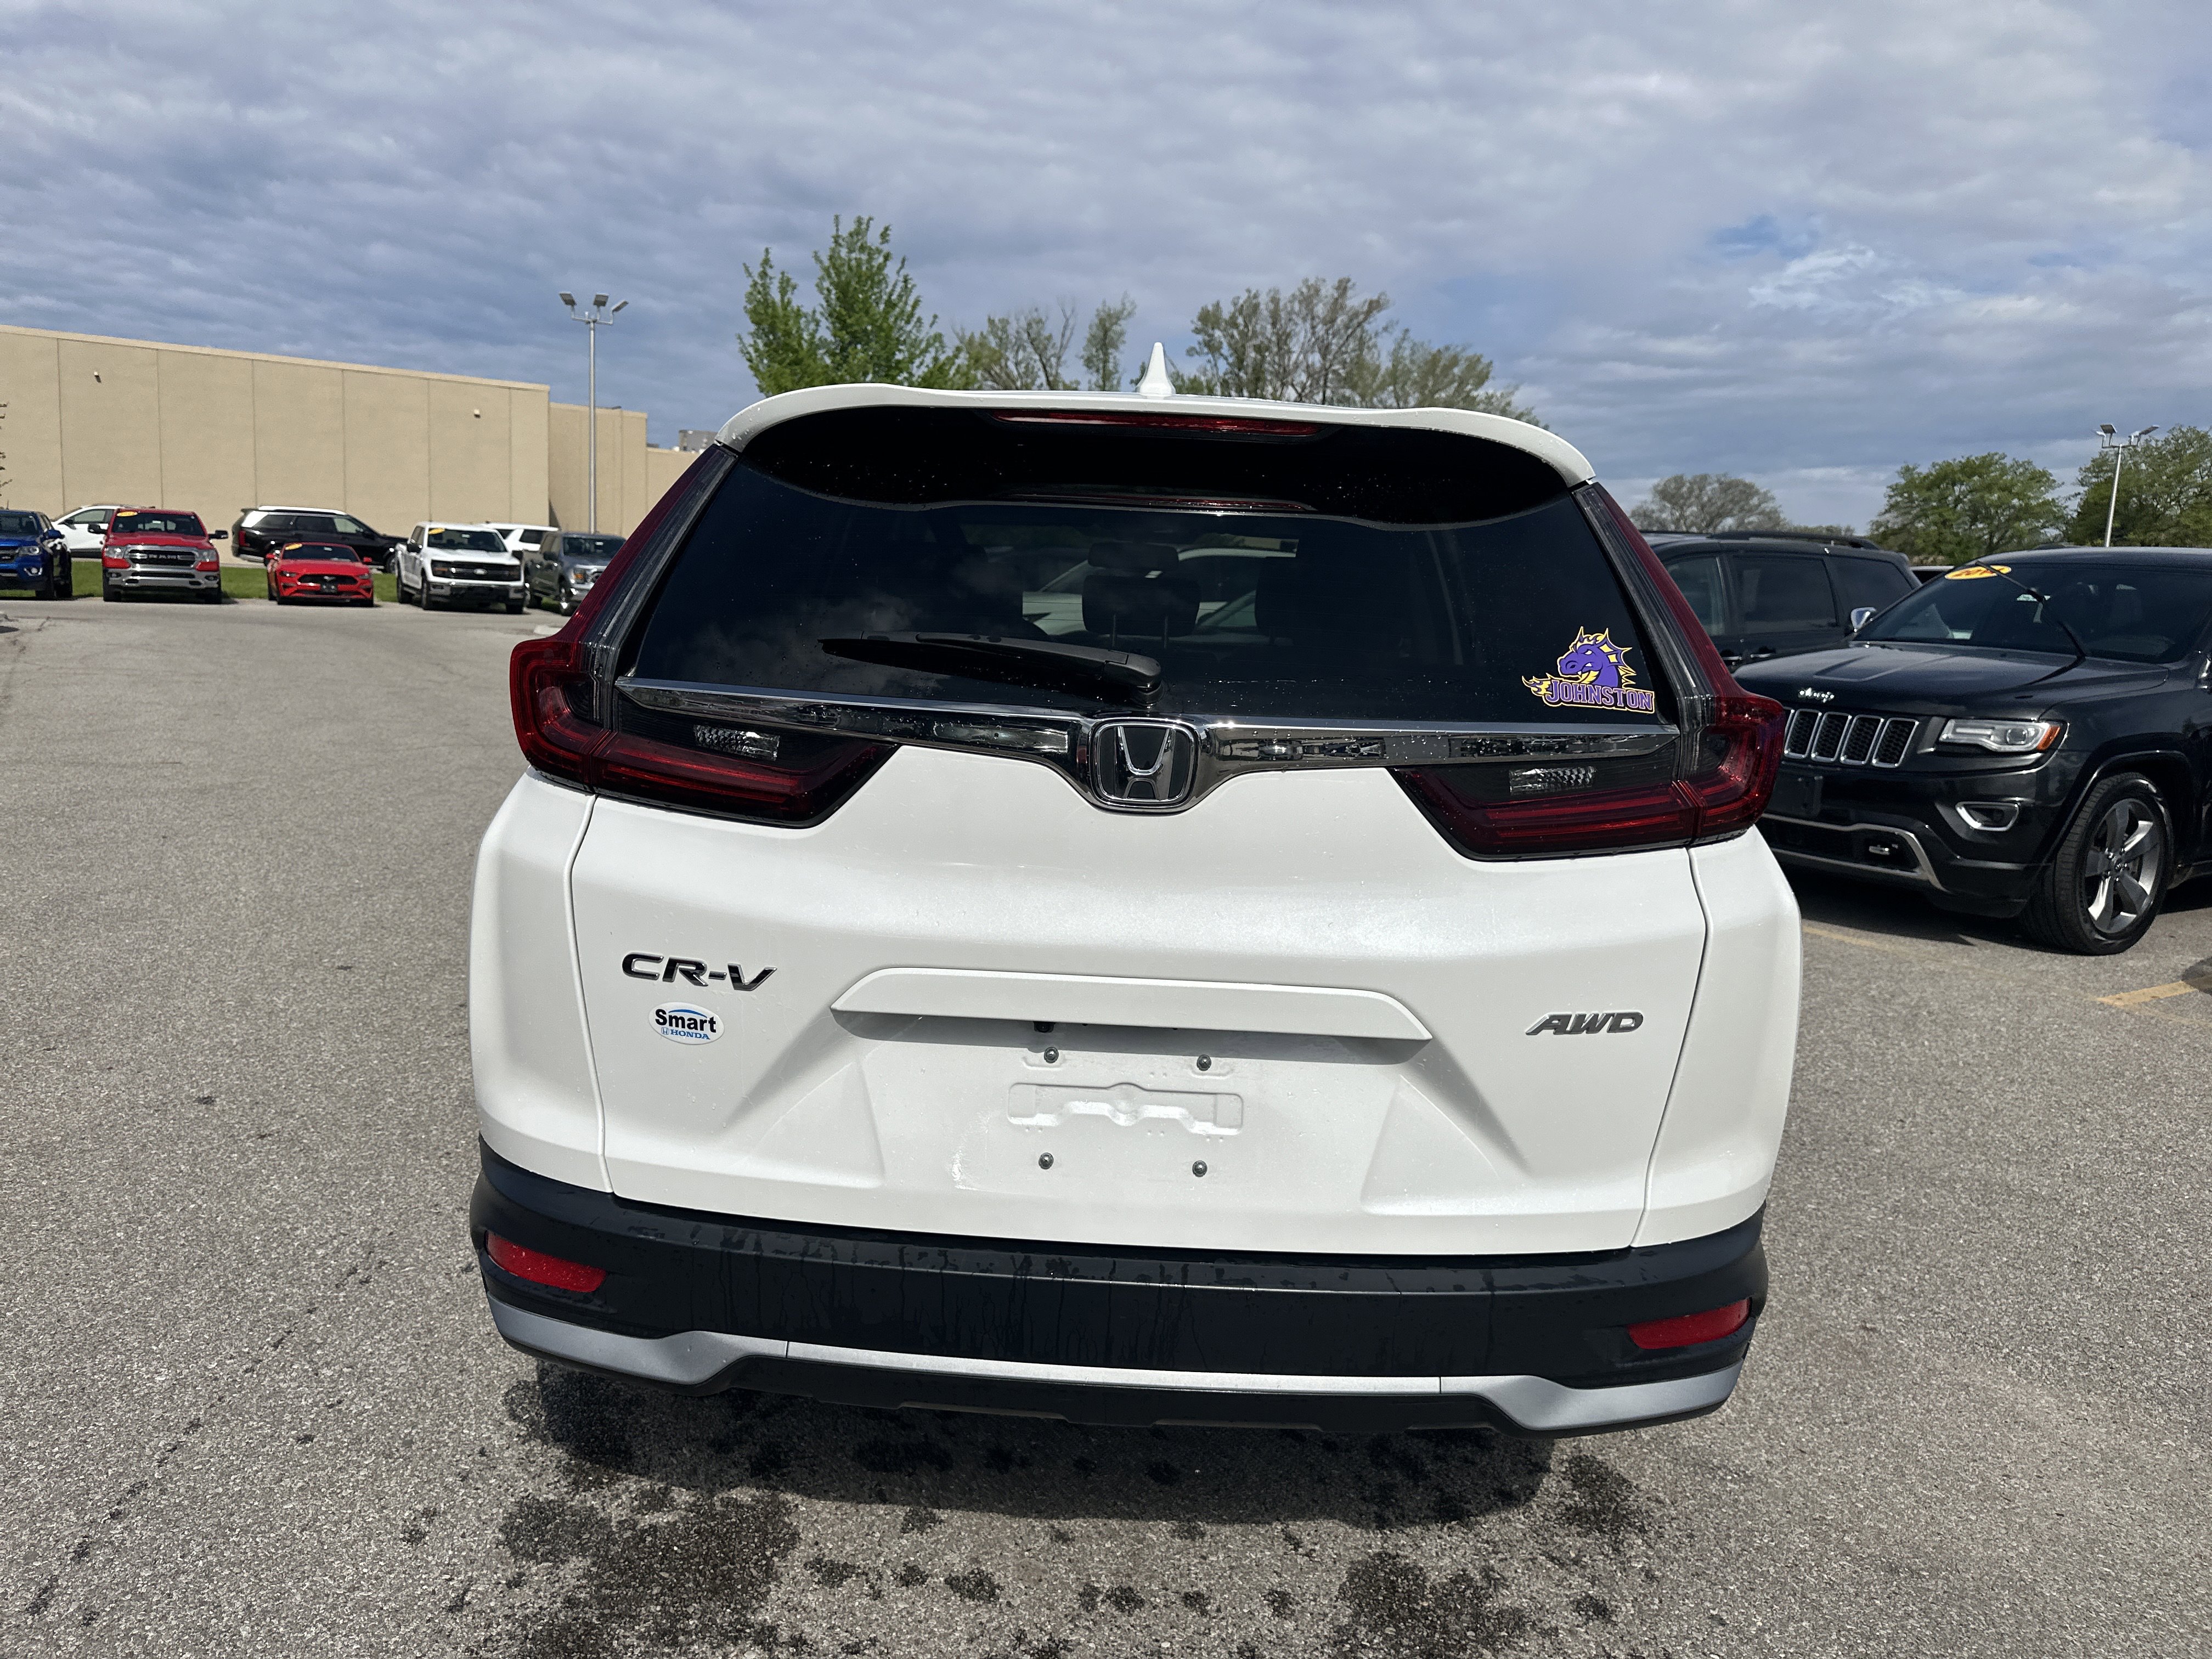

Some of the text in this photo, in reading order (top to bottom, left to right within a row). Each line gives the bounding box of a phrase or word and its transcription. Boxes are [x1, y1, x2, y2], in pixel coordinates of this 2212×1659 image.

[1545, 679, 1653, 710] JOHNSTON
[622, 952, 777, 991] CR-V
[655, 1008, 716, 1033] Smart
[1525, 1013, 1644, 1035] AWD
[670, 1029, 710, 1040] HONDA
